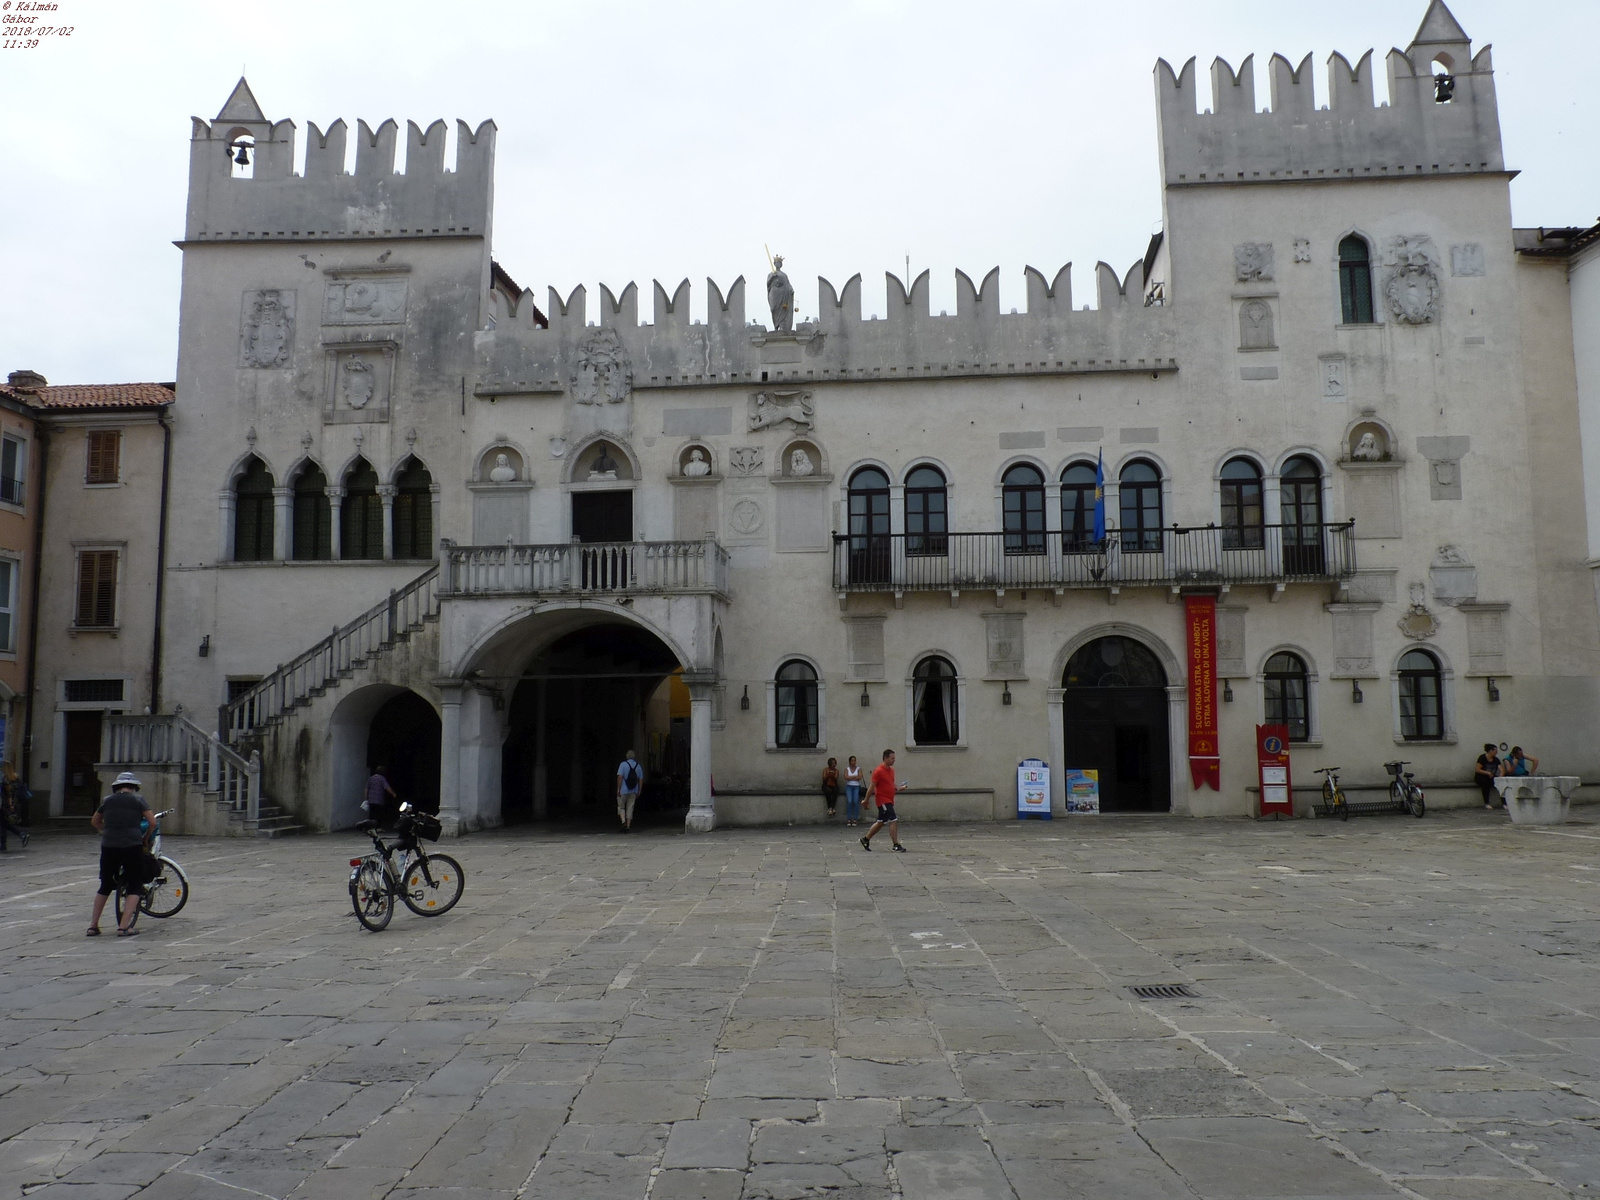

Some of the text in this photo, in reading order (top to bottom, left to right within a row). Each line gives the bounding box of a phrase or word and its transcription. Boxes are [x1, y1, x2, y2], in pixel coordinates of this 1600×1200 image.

[1202, 643, 1210, 658] UNA
[1203, 660, 1210, 668] DI
[1194, 664, 1202, 686] ISTRA
[1195, 687, 1203, 728] SLOVENSKA
